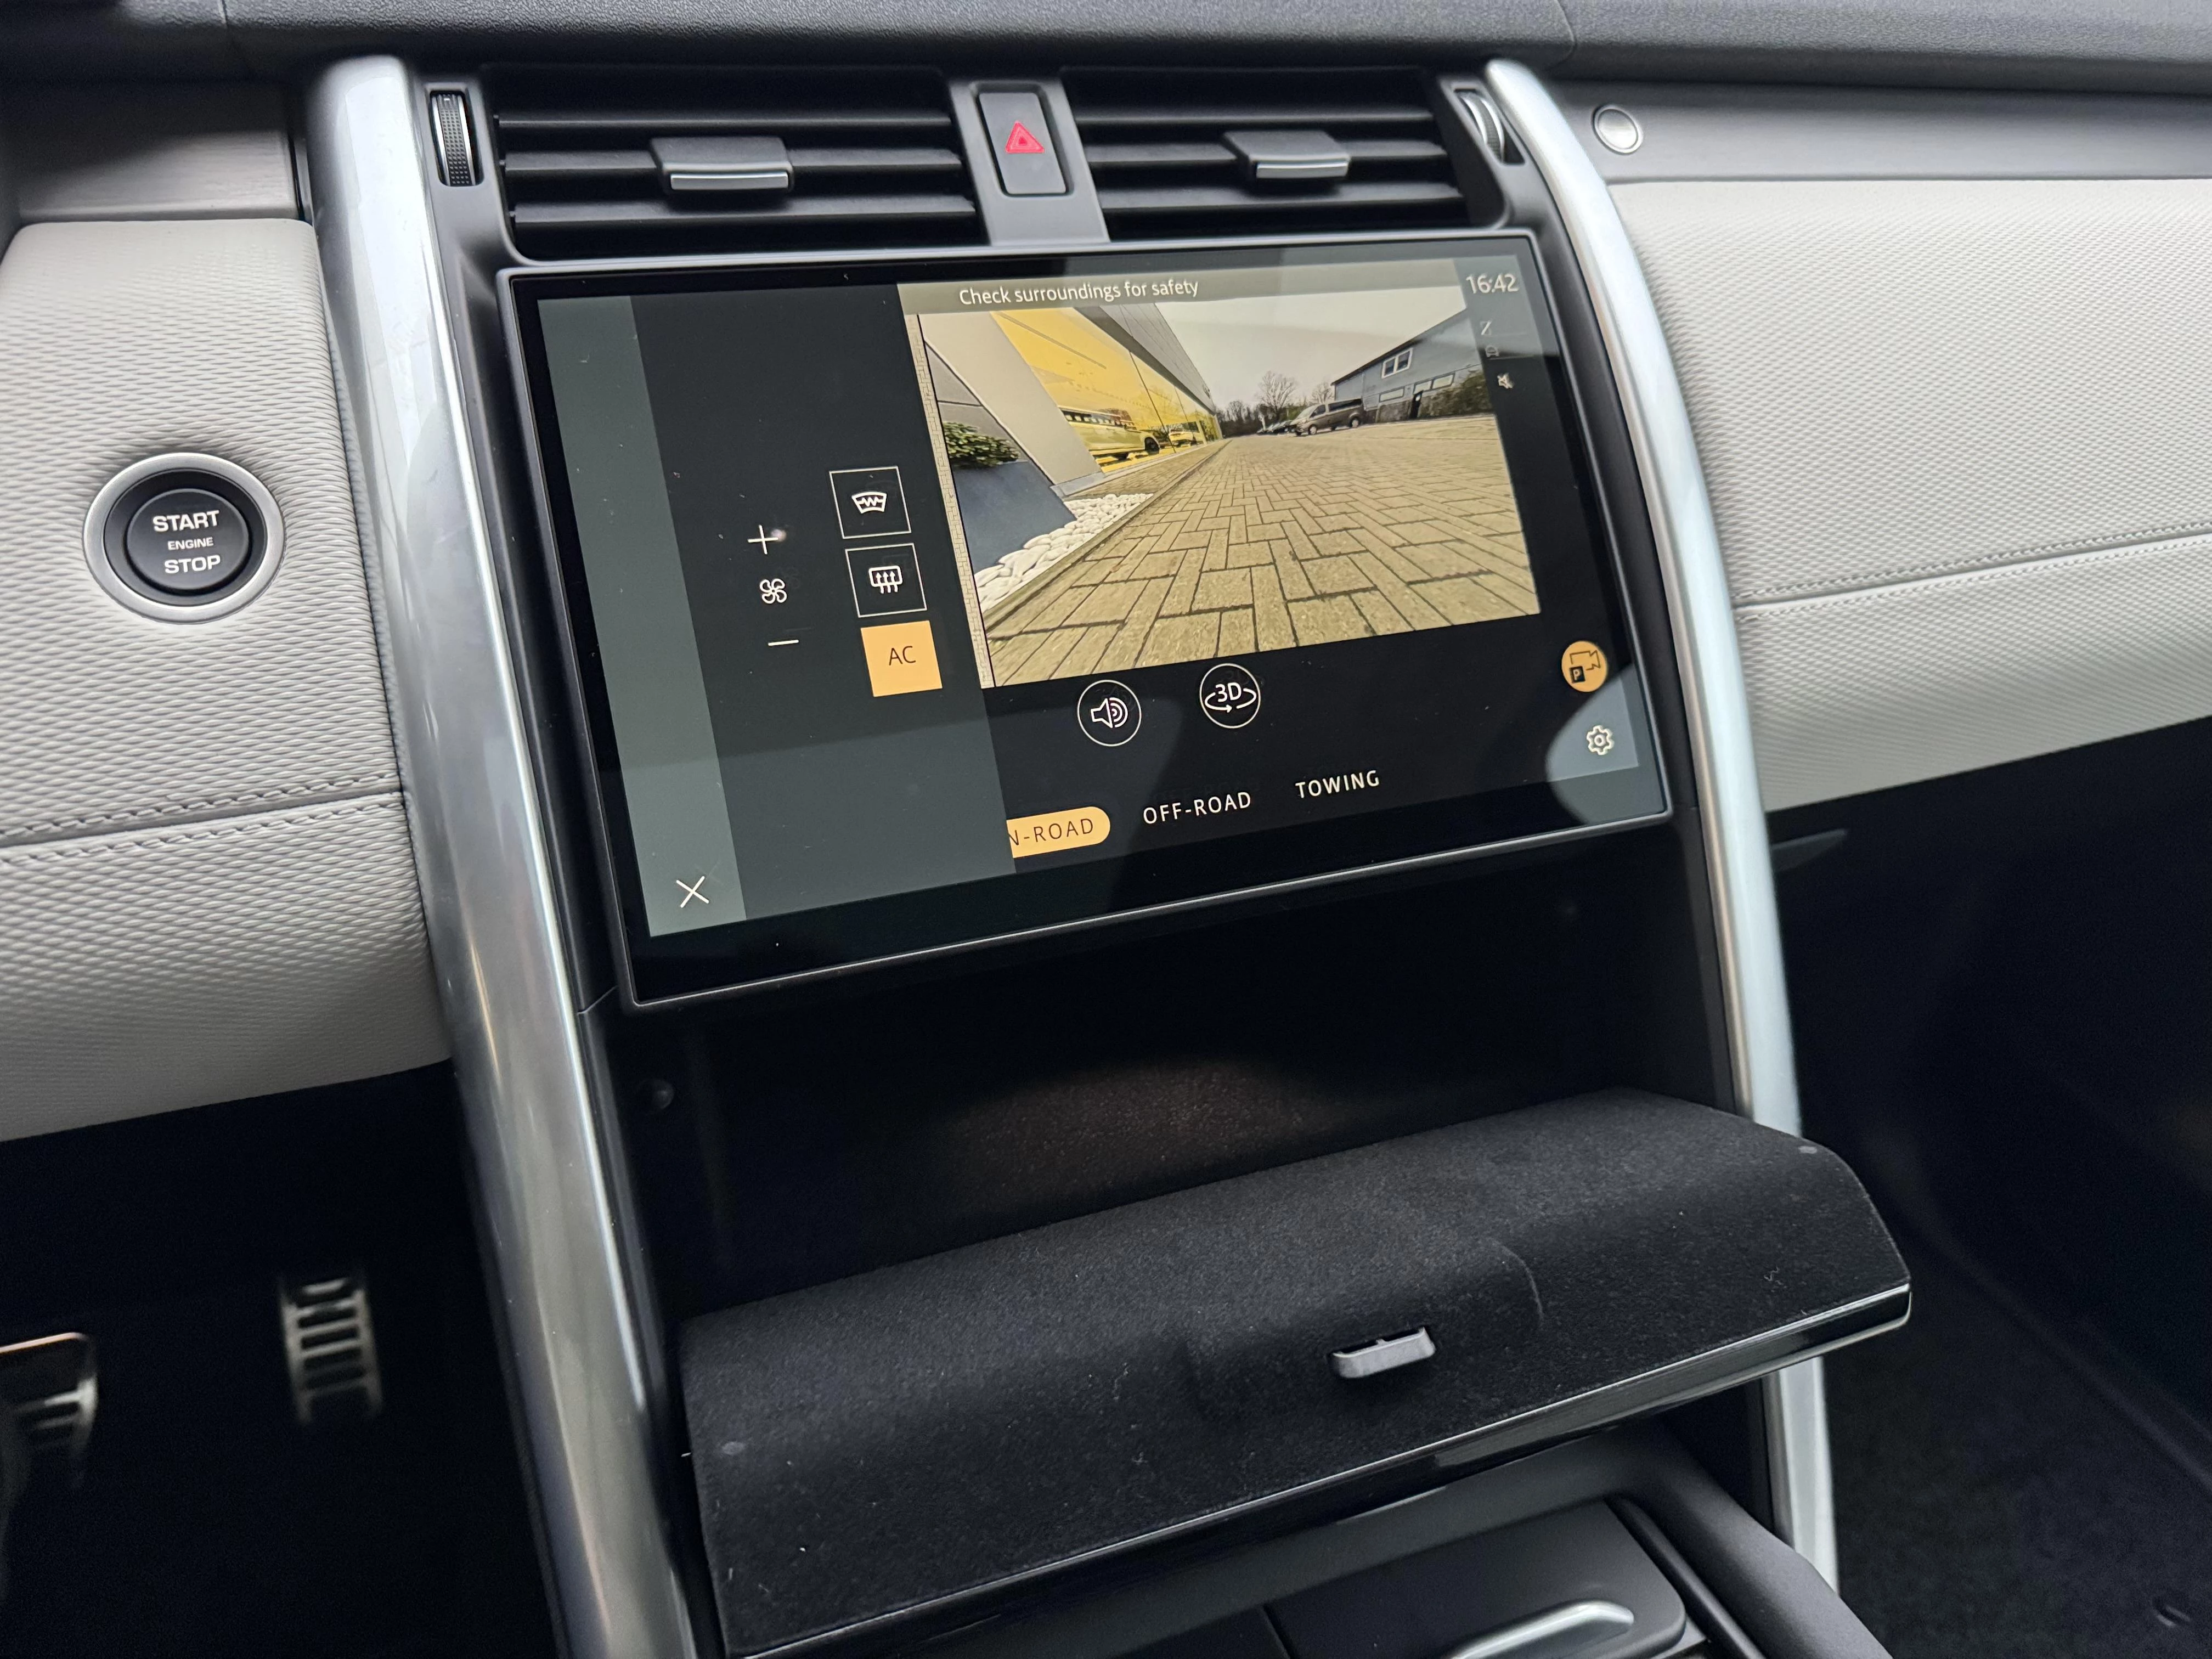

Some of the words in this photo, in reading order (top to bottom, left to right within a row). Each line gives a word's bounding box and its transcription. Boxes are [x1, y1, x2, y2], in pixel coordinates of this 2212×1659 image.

[959, 285, 1009, 305] Check
[1014, 282, 1121, 302] surroundings
[1124, 281, 1147, 297] for
[1152, 278, 1199, 297] safety
[1465, 273, 1519, 294] 16:42
[153, 510, 219, 532] START
[167, 537, 214, 550] ENGINE
[164, 554, 221, 574] STOP
[889, 645, 916, 666] AC
[1215, 682, 1242, 702] 3D
[1295, 770, 1380, 799] TOWING
[1143, 791, 1251, 824] OFF-ROAD
